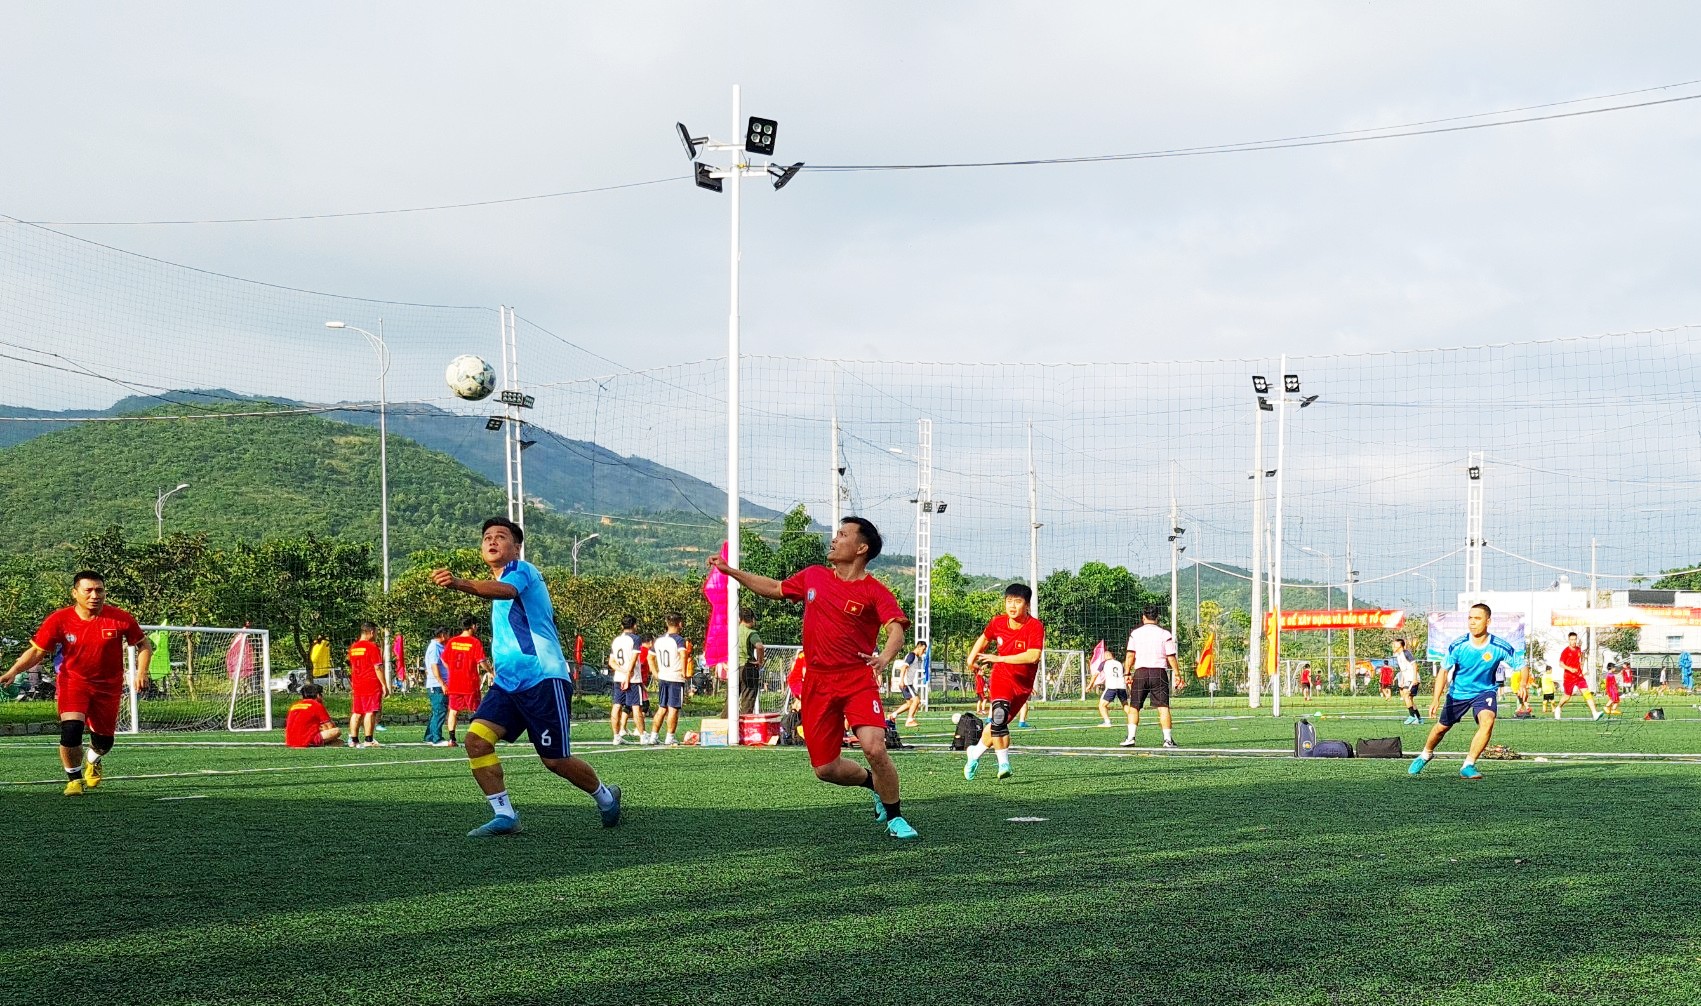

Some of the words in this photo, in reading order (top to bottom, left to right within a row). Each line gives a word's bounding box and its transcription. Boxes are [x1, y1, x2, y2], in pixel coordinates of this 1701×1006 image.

[617, 648, 625, 666] 9
[658, 649, 670, 668] 10
[873, 700, 880, 714] 8
[541, 728, 552, 746] 6
